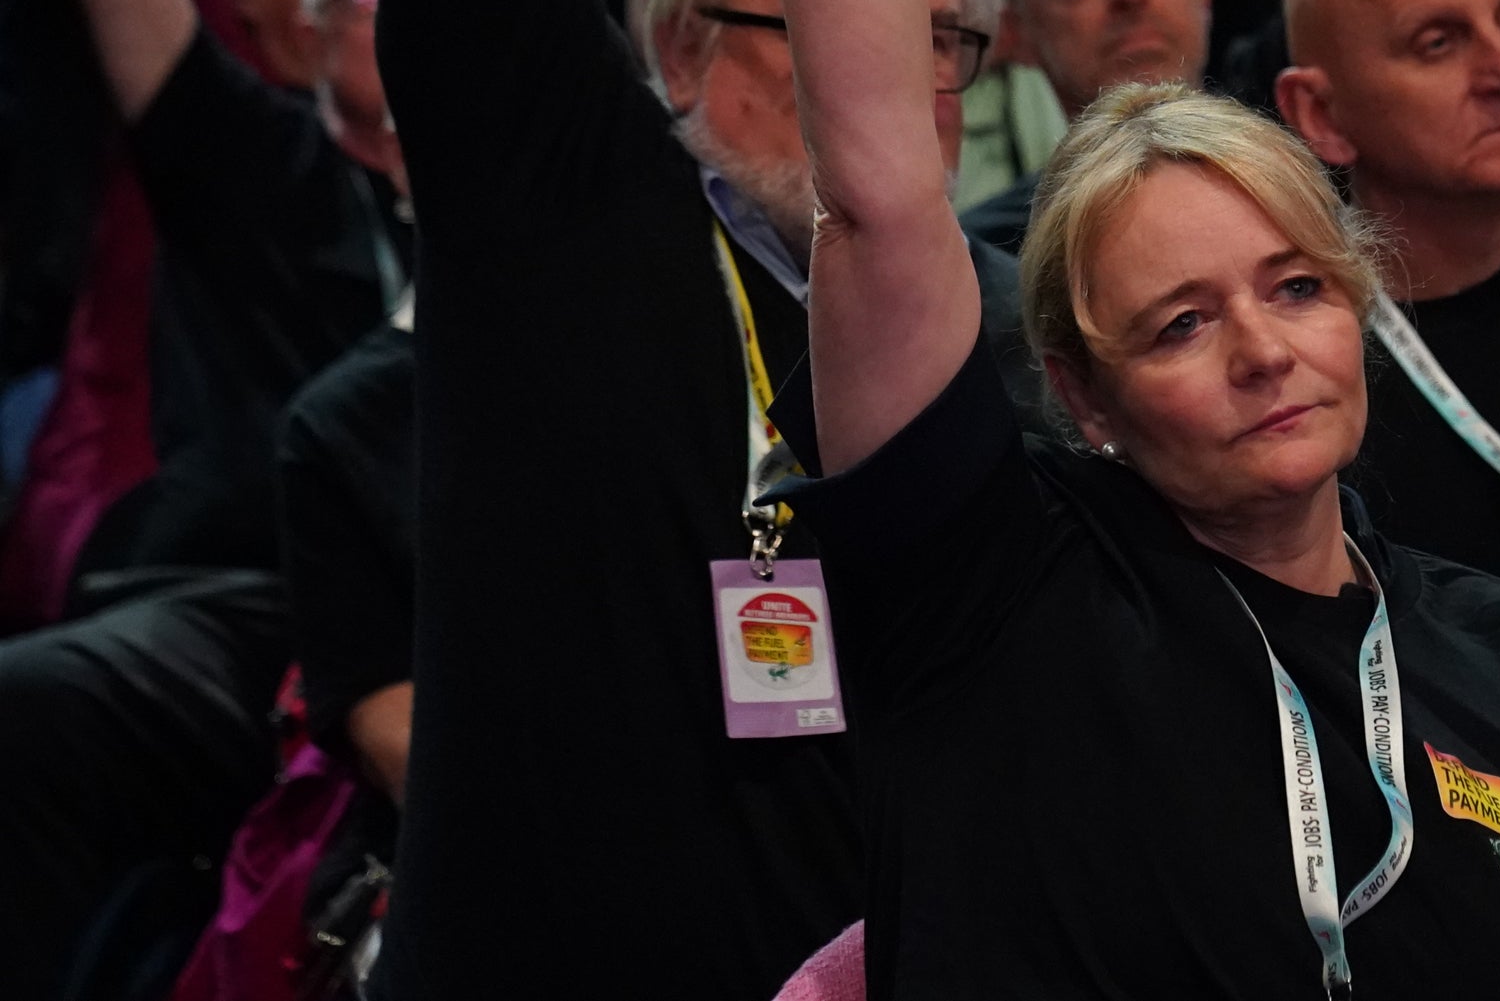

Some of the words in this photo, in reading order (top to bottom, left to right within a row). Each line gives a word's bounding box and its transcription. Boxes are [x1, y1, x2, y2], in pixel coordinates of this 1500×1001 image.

[1374, 639, 1383, 665] Fighting
[1441, 766, 1474, 793] THE
[1315, 855, 1324, 867] for
[1307, 856, 1317, 893] Fighting
